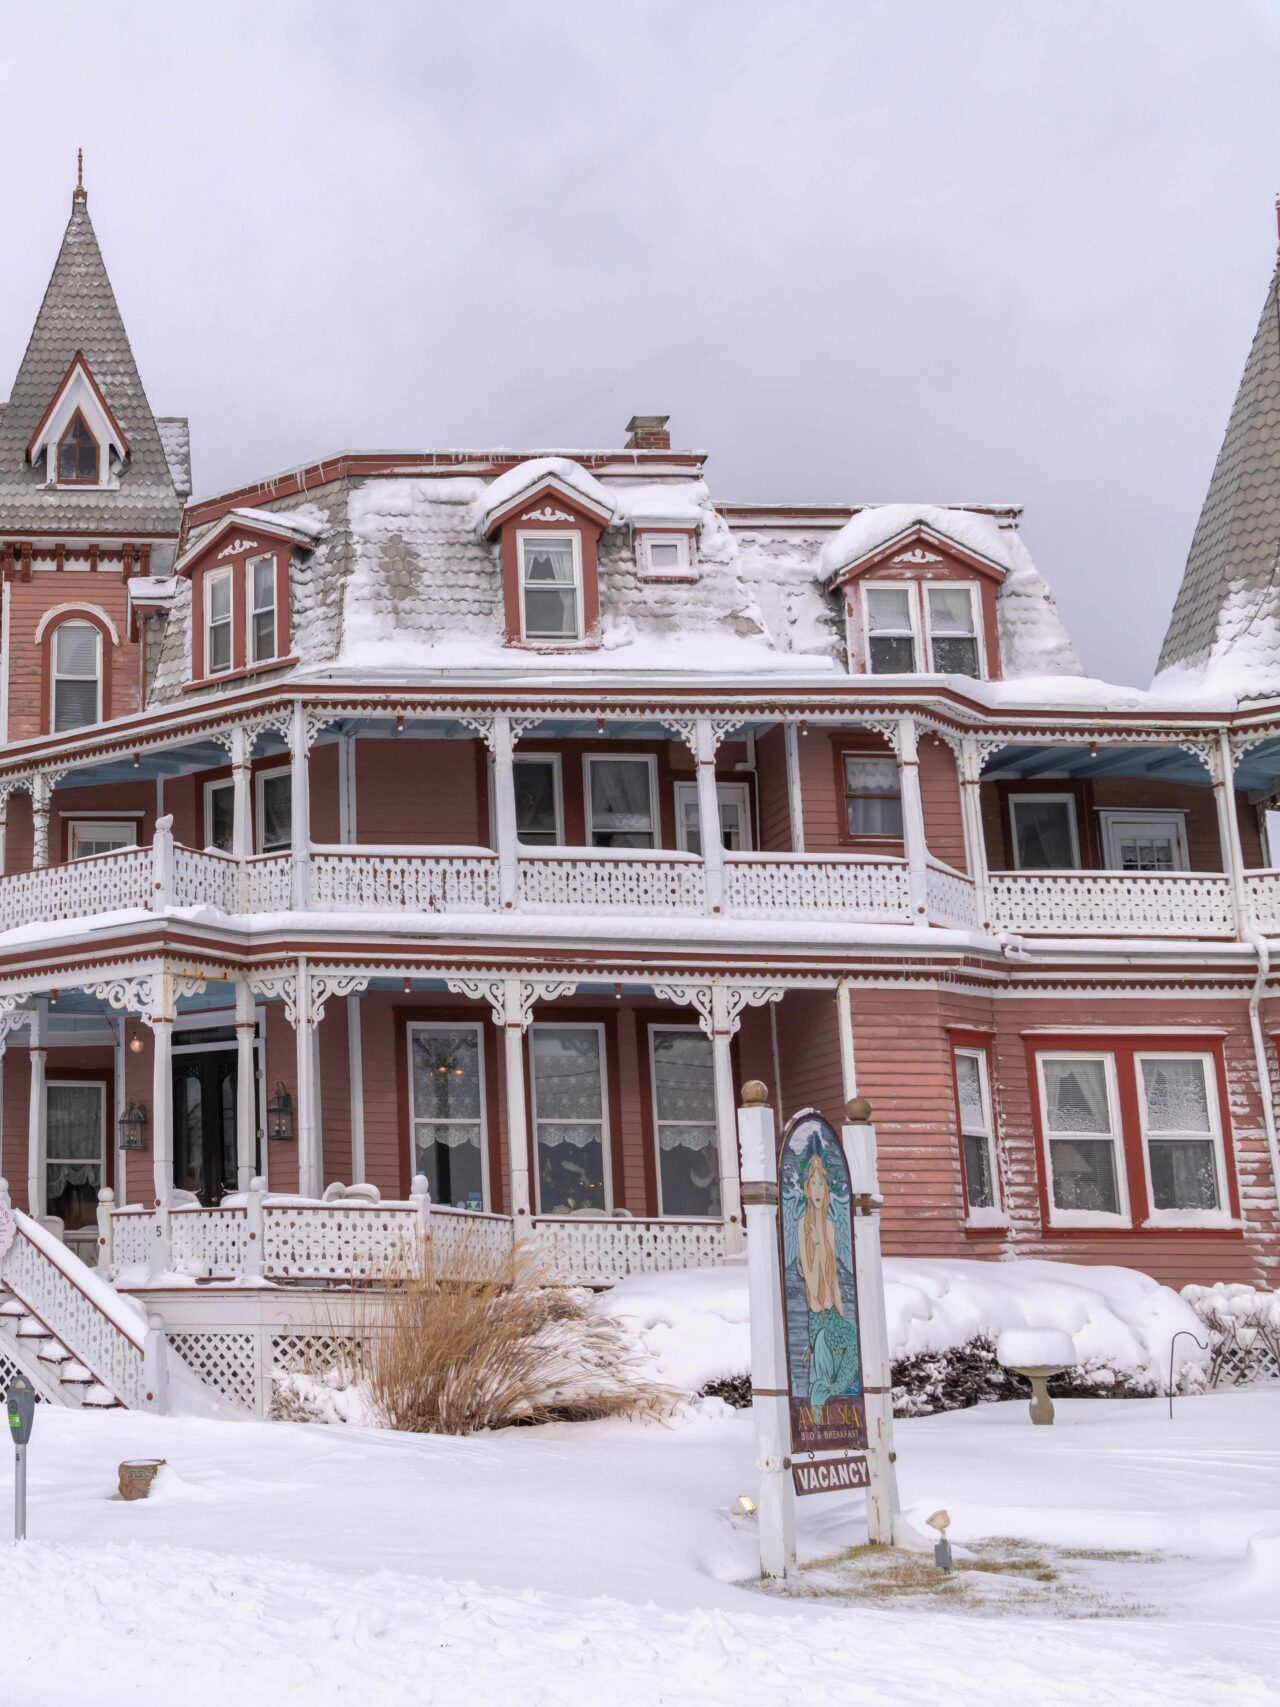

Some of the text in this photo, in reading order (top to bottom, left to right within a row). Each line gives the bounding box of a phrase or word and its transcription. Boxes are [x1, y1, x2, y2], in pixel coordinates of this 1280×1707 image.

[156, 1225, 162, 1237] 5
[839, 1405, 860, 1428] SEA
[823, 1429, 859, 1440] BREAKFAST
[798, 1462, 866, 1489] VACANCY
